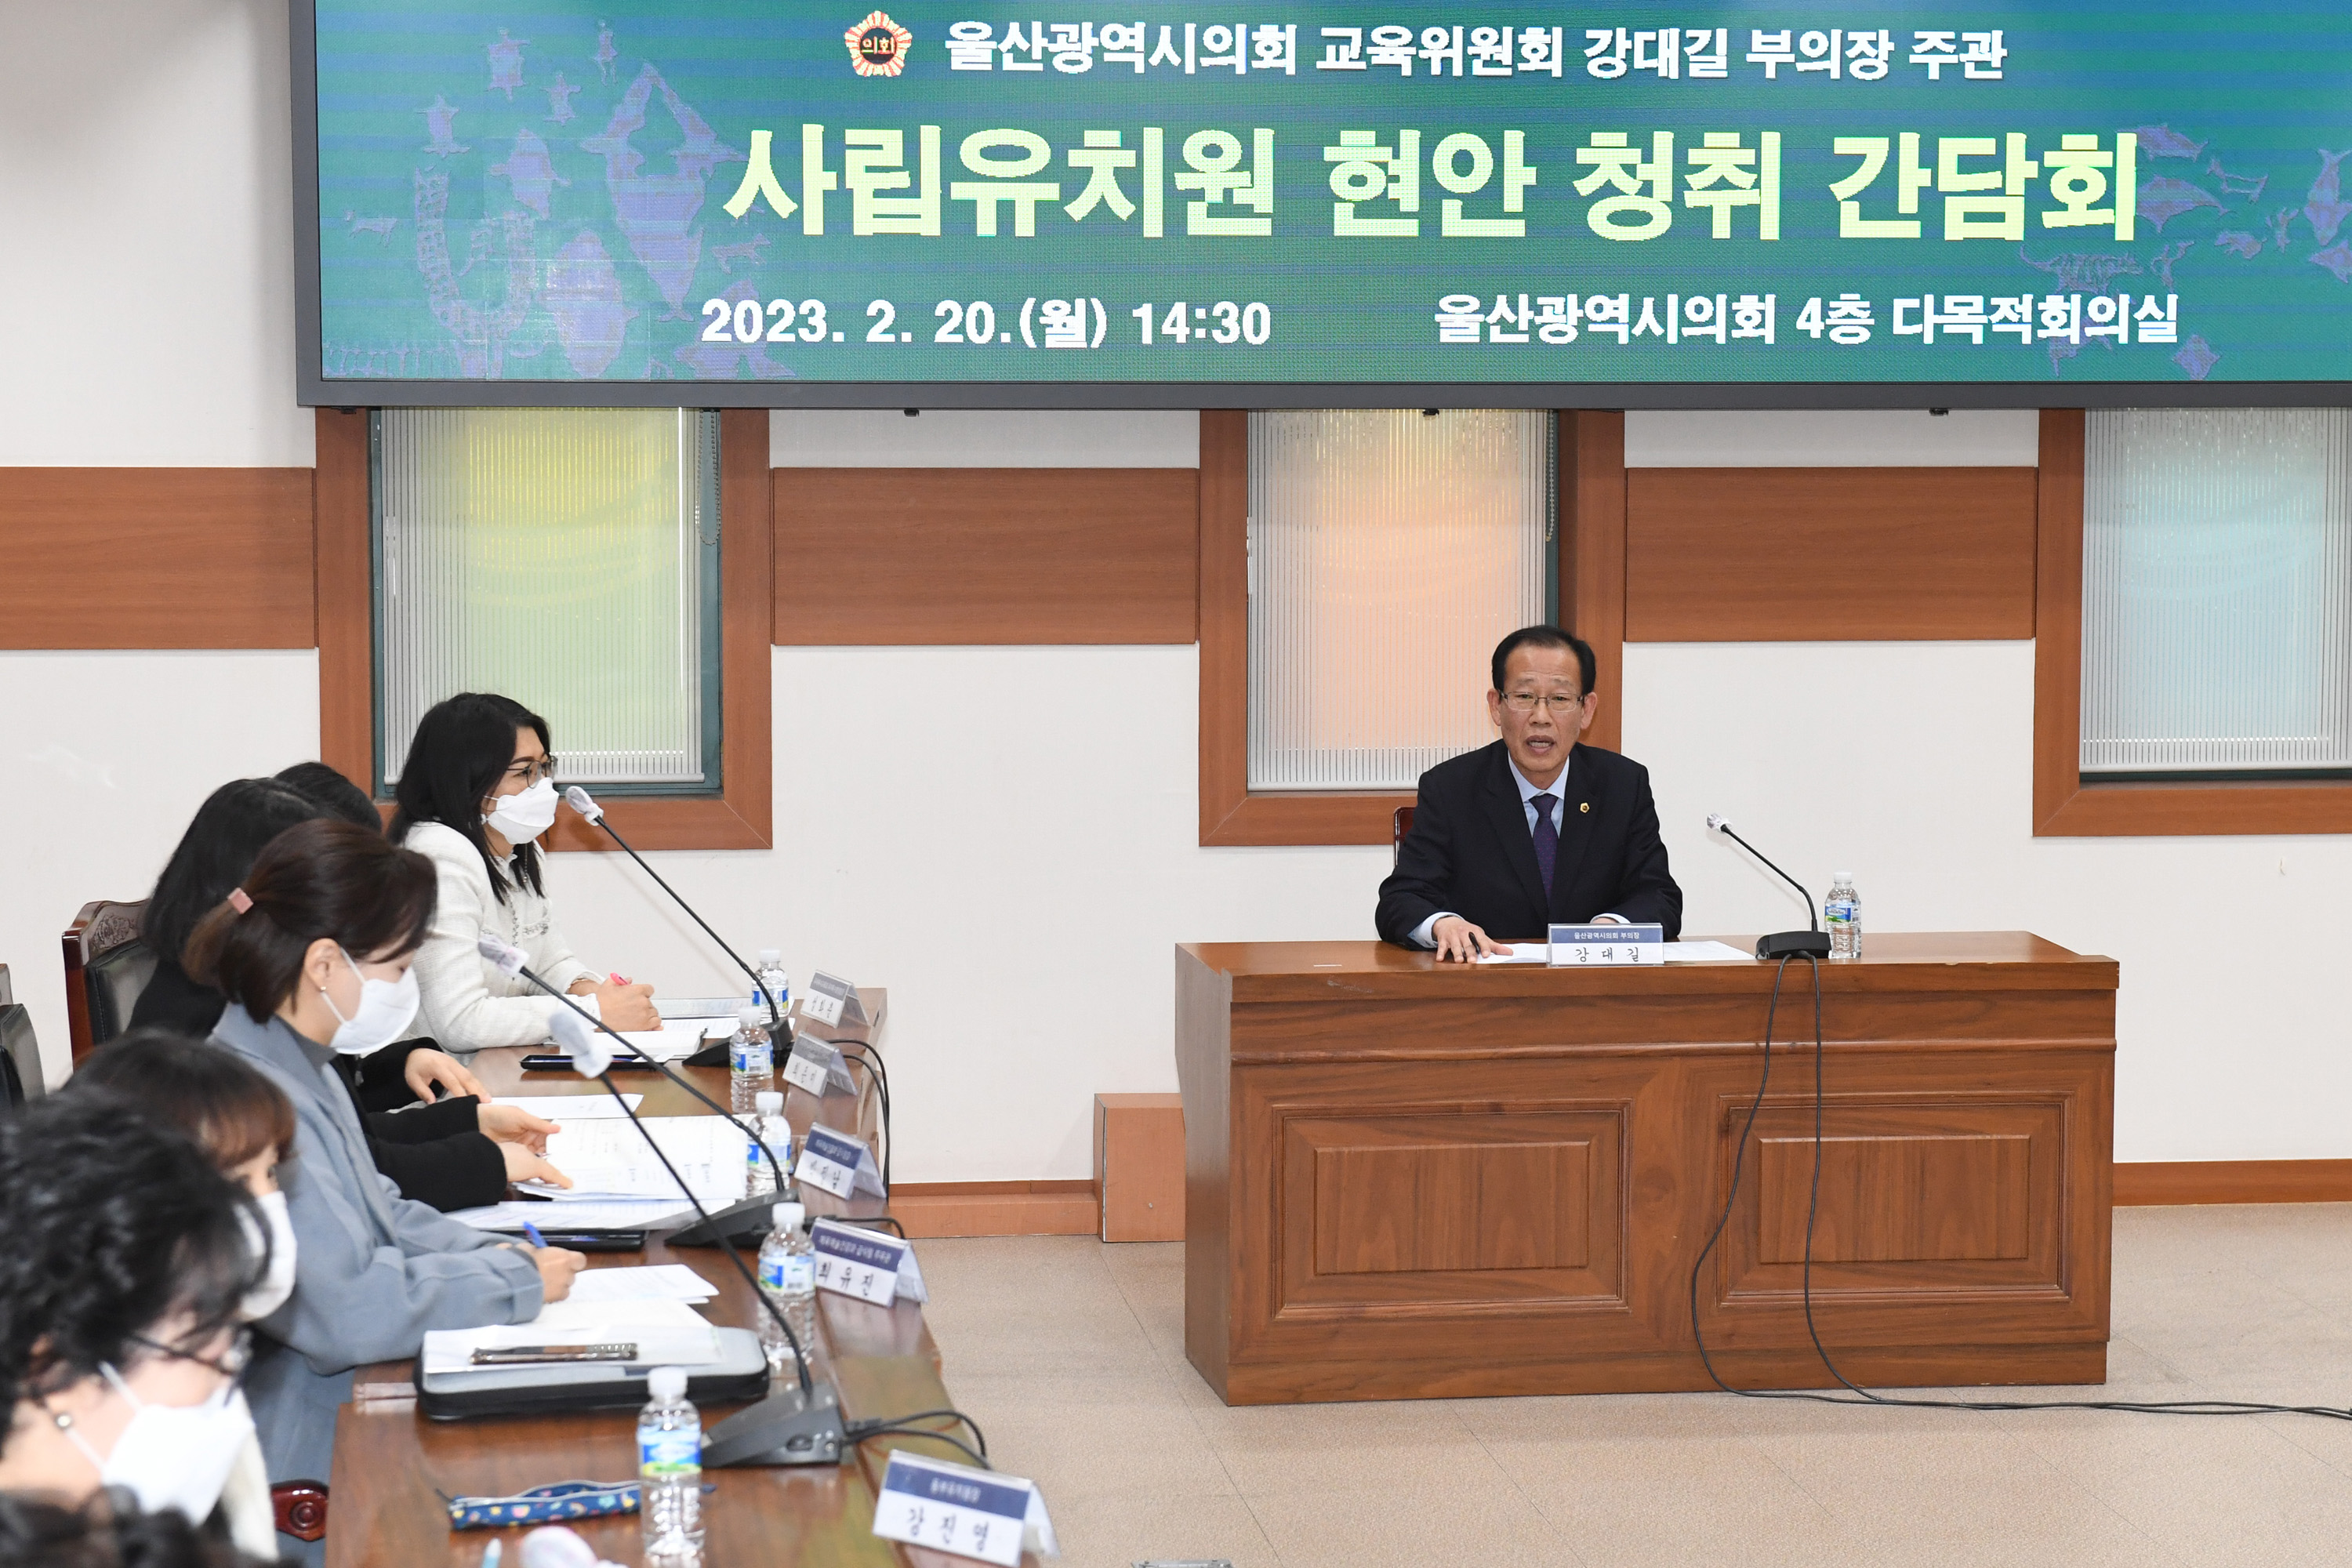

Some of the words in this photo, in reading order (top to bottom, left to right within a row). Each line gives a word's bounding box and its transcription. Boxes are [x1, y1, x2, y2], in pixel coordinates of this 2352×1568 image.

[861, 36, 895, 55] 의회
[945, 20, 1298, 76] 울산광역시의회
[1315, 24, 1563, 78] 교육위원회
[1583, 27, 1729, 80] 강대길
[1746, 28, 1896, 82] 부의장
[1908, 29, 2009, 81] 주관
[722, 122, 1276, 238] 사립유치원
[1323, 129, 1537, 238] 현안
[1572, 130, 1782, 241] 청취
[1828, 131, 2138, 241] 간담회
[701, 298, 845, 344] 2023.
[866, 299, 913, 343] 2.
[934, 297, 1108, 350] 20.(월)
[1132, 300, 1272, 345] 14:30
[1433, 292, 1777, 345] 울산광역시의회
[1795, 292, 1876, 346] 4층
[1892, 292, 2180, 346] 다목적회의실
[1573, 931, 1619, 940] 울산광역시의회
[1620, 931, 1640, 940] 부의장
